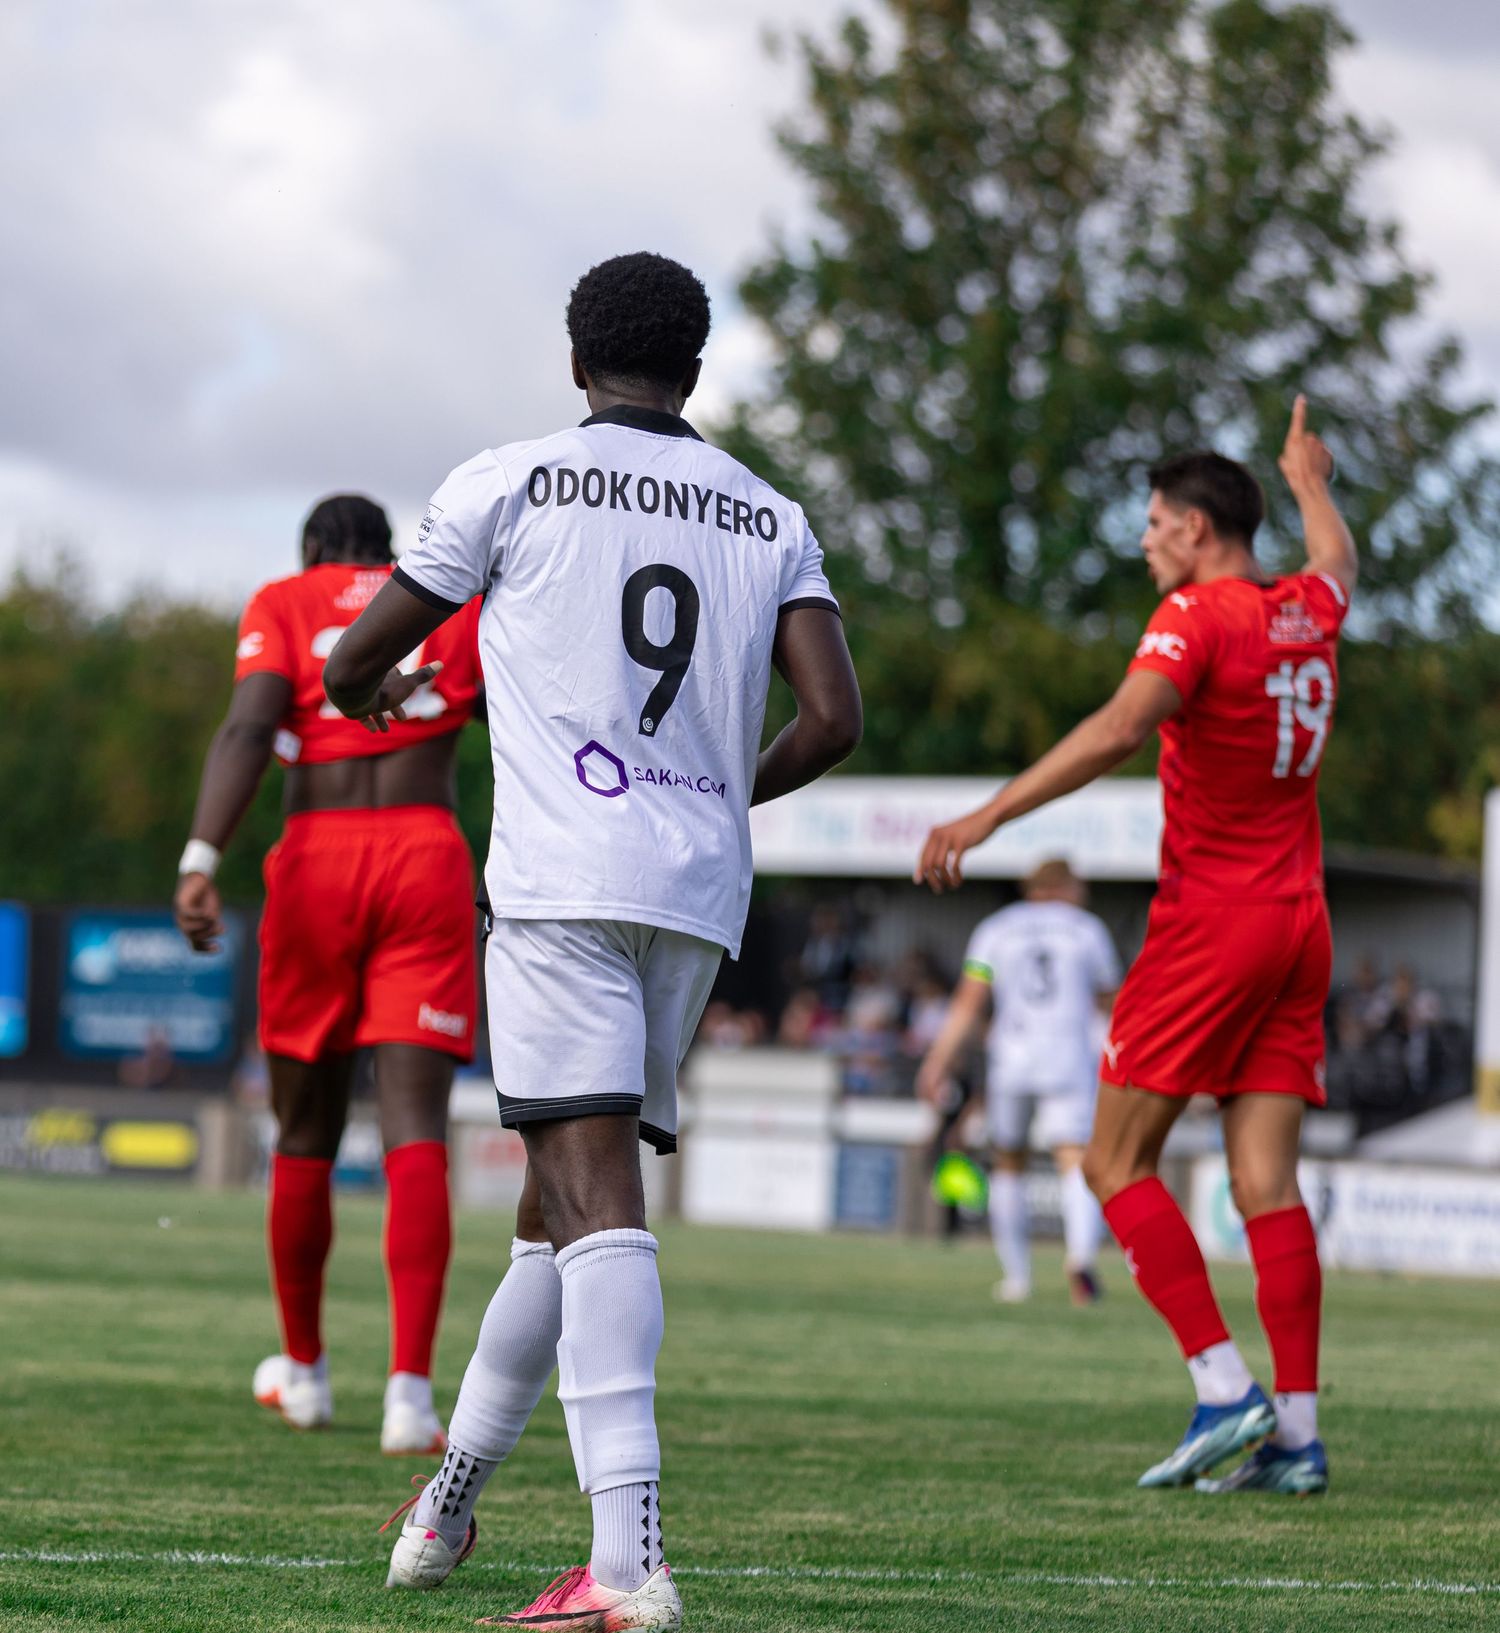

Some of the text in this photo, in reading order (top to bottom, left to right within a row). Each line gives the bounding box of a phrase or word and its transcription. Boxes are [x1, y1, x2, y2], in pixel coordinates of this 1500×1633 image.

[528, 466, 778, 542] ODOKONYERO
[621, 563, 700, 737] 9
[1265, 657, 1334, 778] 19
